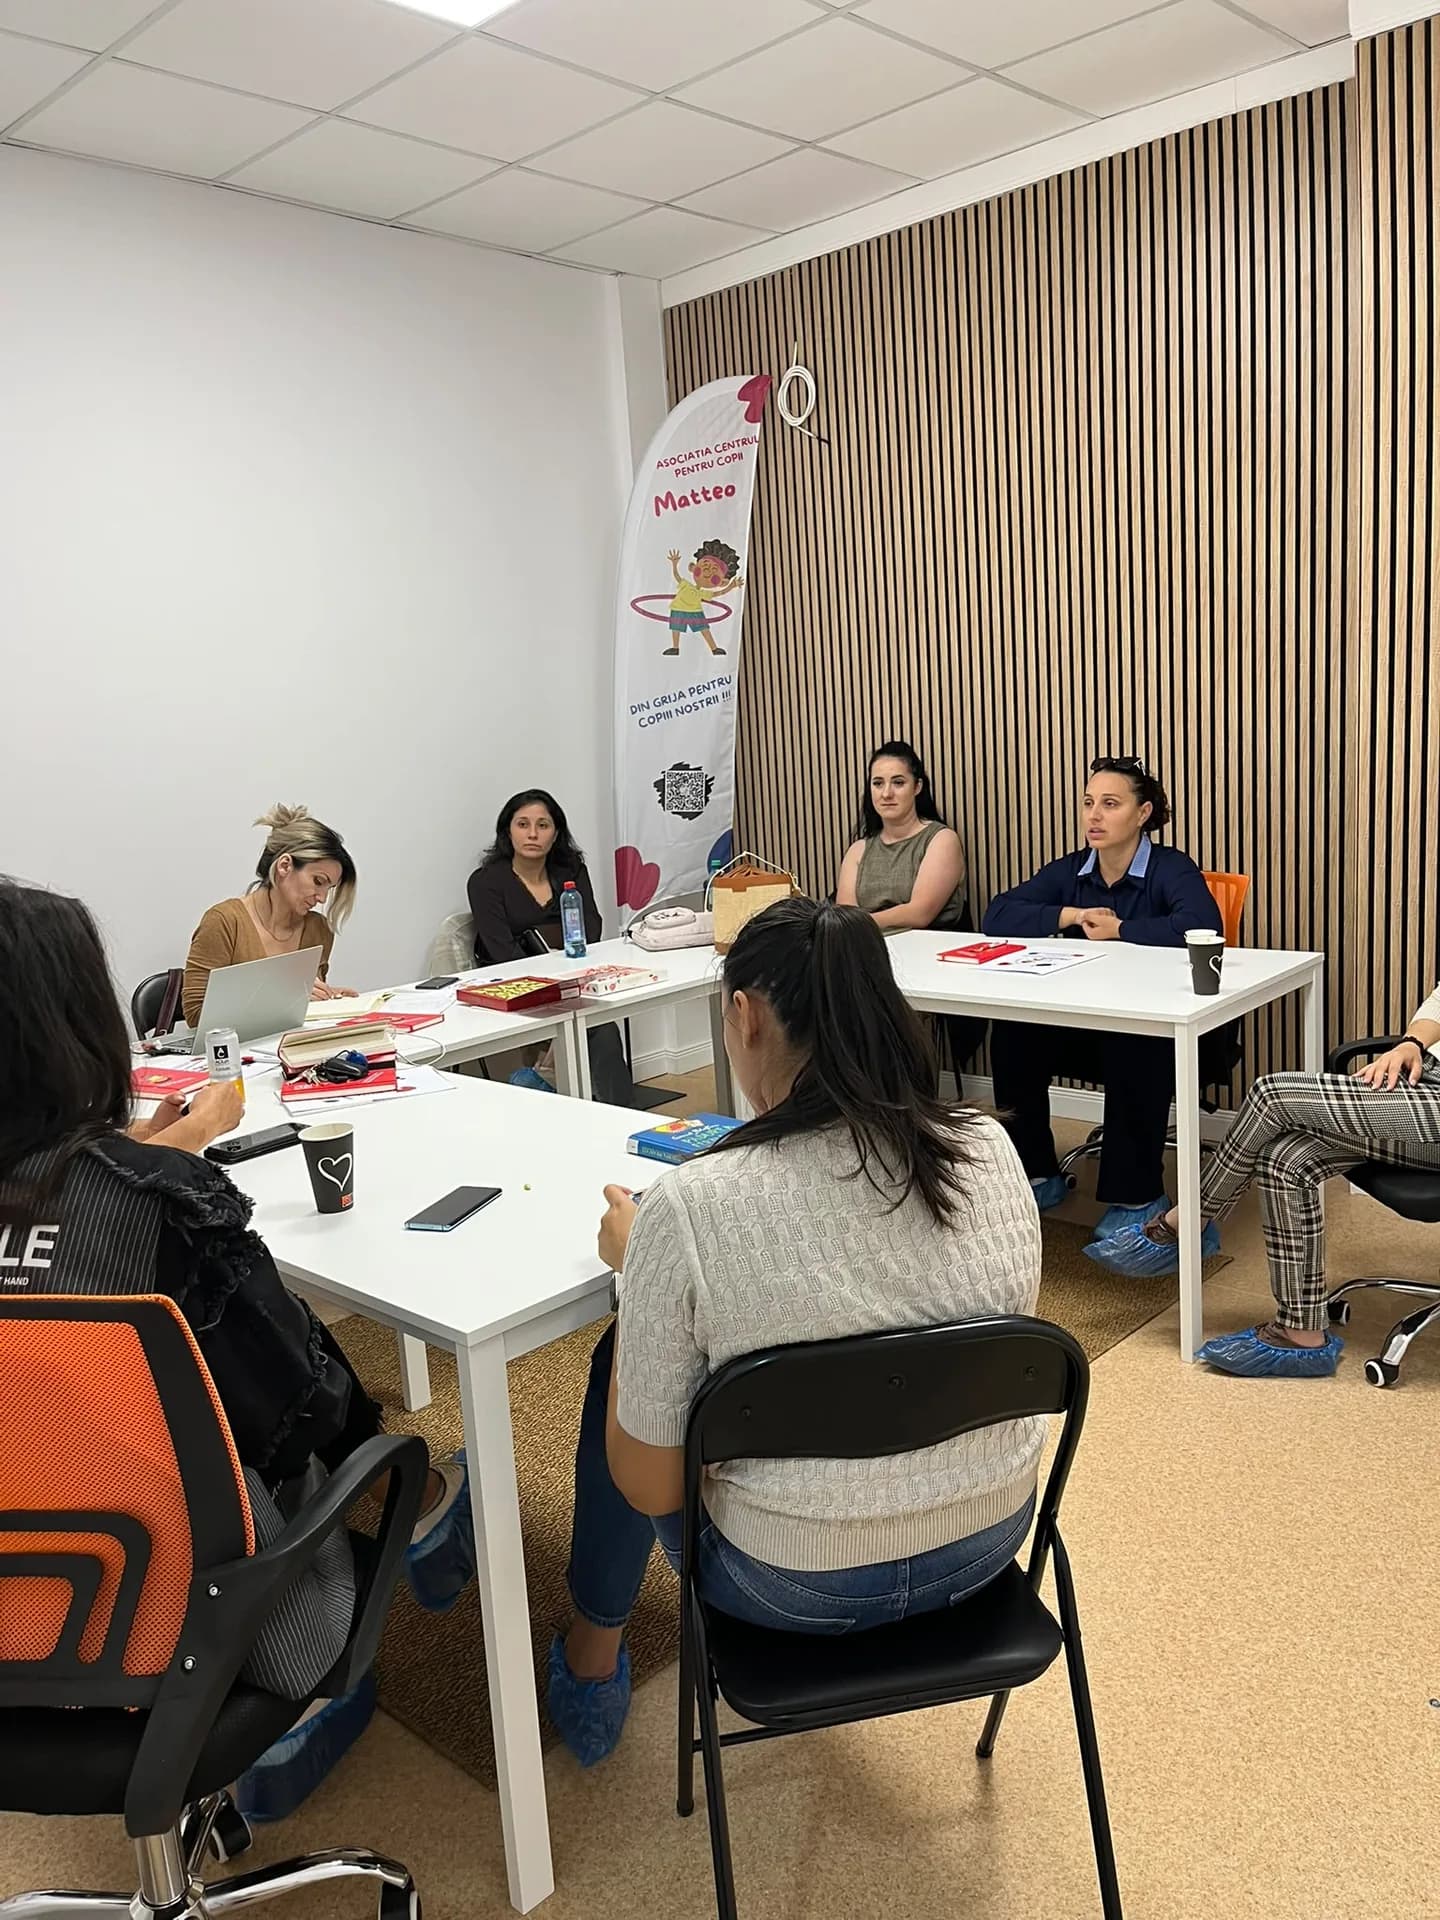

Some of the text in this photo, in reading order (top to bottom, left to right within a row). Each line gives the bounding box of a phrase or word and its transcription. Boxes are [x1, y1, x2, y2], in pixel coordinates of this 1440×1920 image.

[656, 435, 759, 469] ASOCIATIA CENTRUL
[674, 451, 744, 478] PENTRU COPII
[654, 484, 736, 517] Matteo
[629, 674, 732, 715] DIN GRIJA PENTRU
[638, 709, 673, 728] COPIII
[674, 694, 719, 717] NOSTRII
[4, 1276, 29, 1285] HAND
